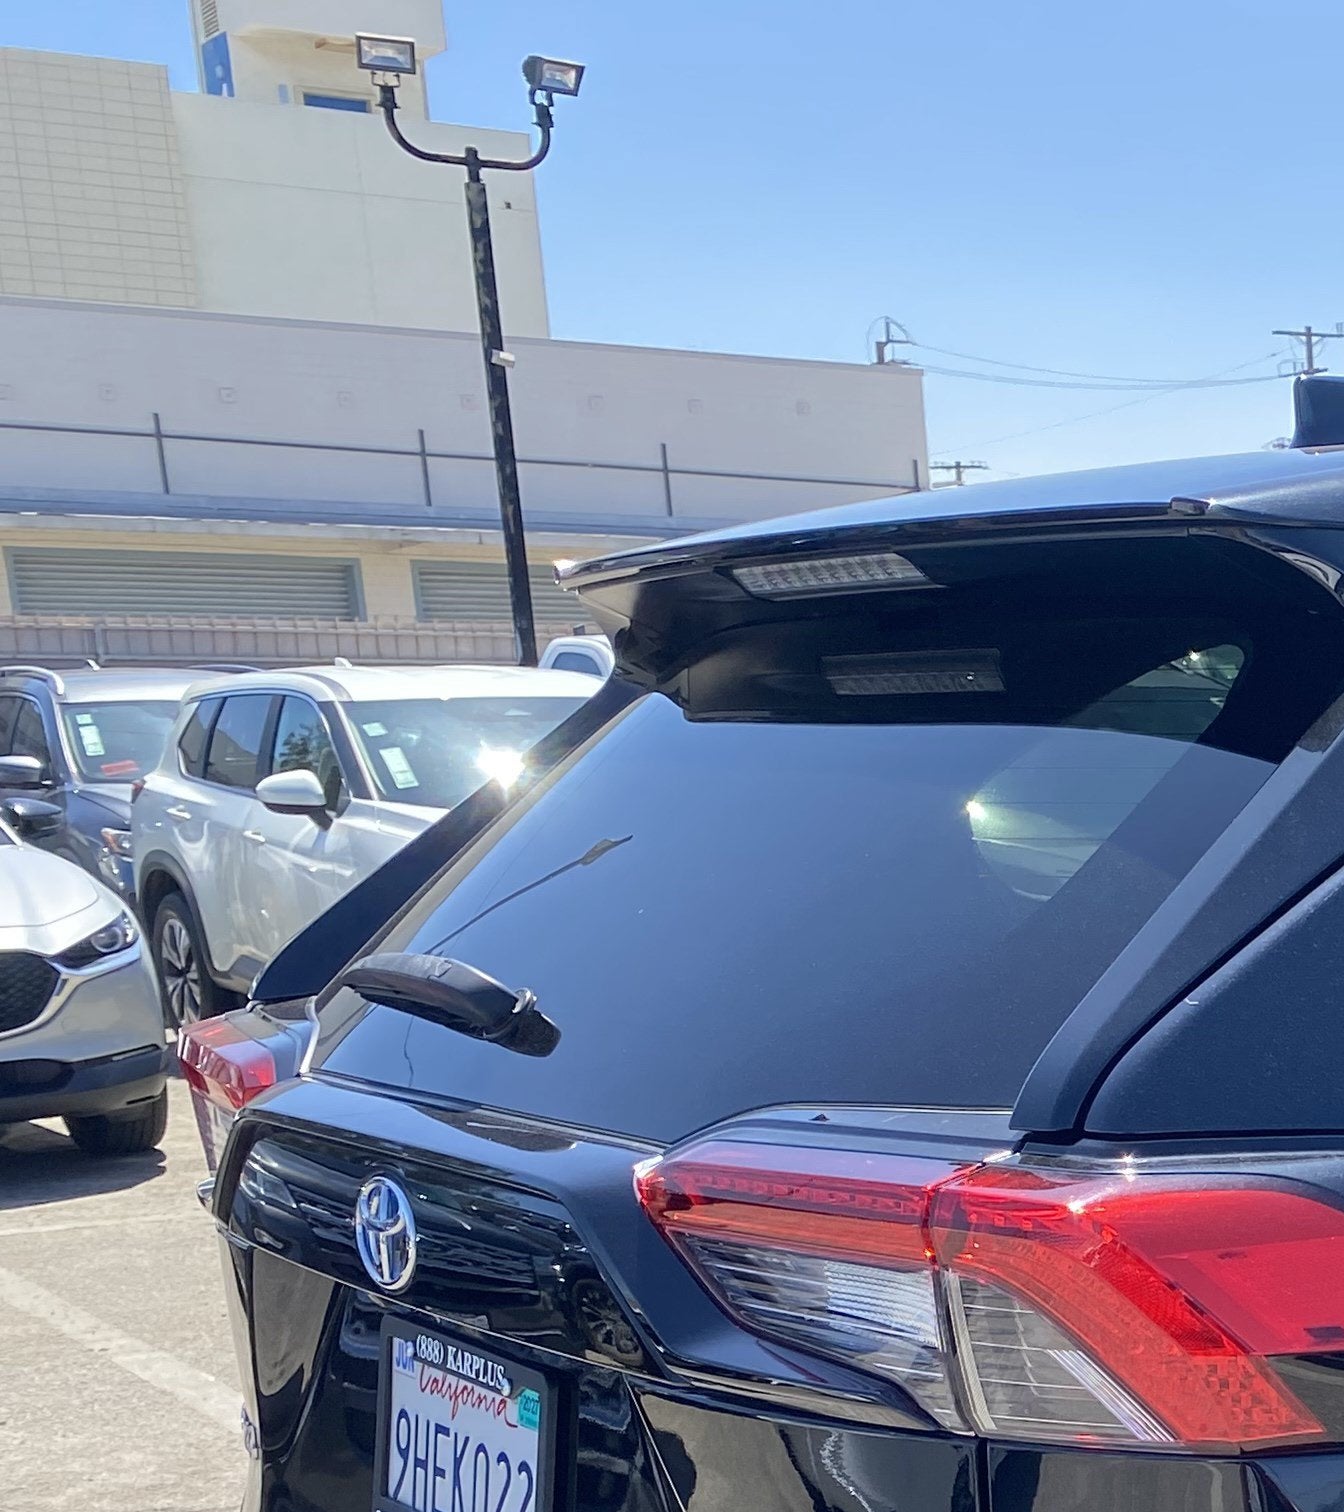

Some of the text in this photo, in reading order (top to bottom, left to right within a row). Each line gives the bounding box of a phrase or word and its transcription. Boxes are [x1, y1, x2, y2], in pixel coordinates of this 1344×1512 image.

[416, 1333, 505, 1390] (888) KARPLUS
[420, 1364, 519, 1428] California
